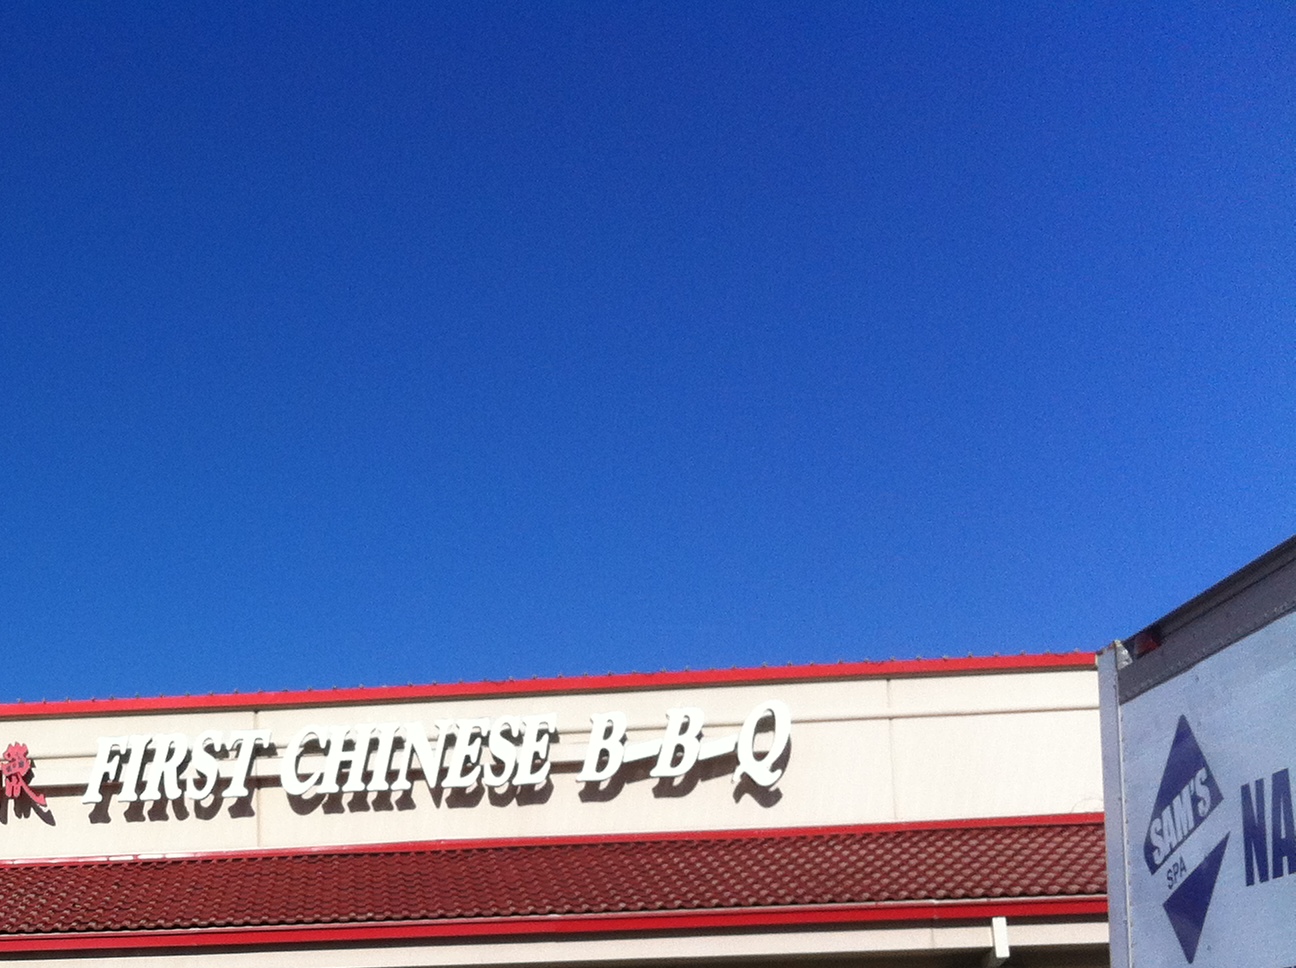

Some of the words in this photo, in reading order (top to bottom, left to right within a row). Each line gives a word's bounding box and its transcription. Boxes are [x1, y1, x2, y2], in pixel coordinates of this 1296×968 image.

[82, 729, 272, 804] FIRST
[280, 712, 557, 796] CHINESE
[1150, 767, 1211, 865] SAM'S
[1166, 857, 1187, 890] SPA
